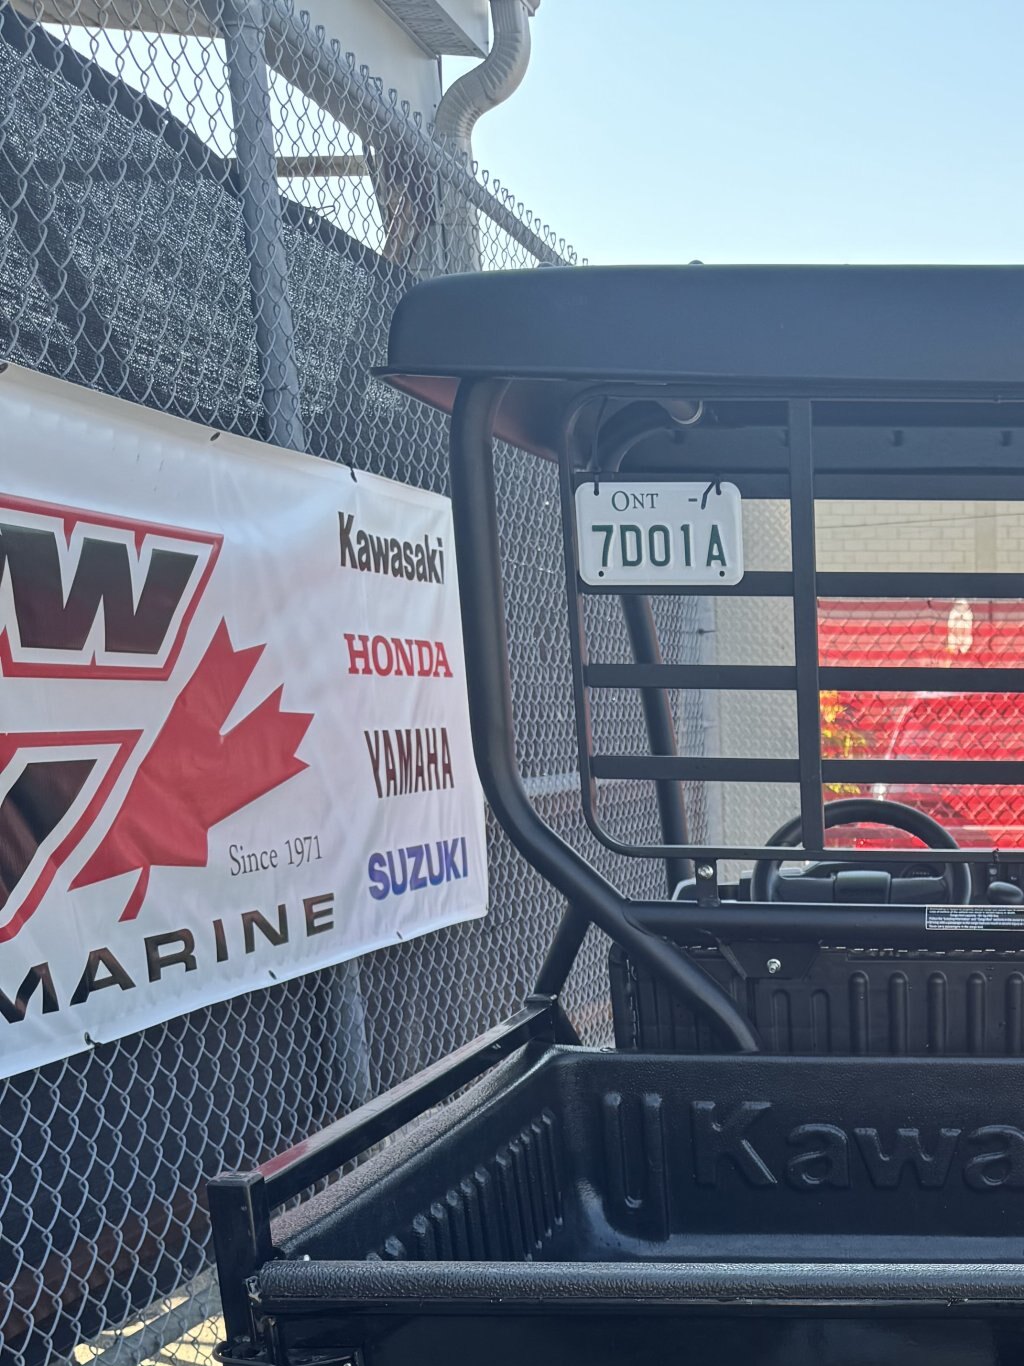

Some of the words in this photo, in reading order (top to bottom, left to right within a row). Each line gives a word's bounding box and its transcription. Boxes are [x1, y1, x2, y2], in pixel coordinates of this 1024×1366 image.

[338, 511, 445, 585] Kawasaki
[343, 633, 454, 678] HONDA
[364, 727, 455, 798] YAMAHA
[229, 843, 279, 877] Since
[284, 834, 323, 868] 1971
[367, 836, 469, 901] SUZUKI
